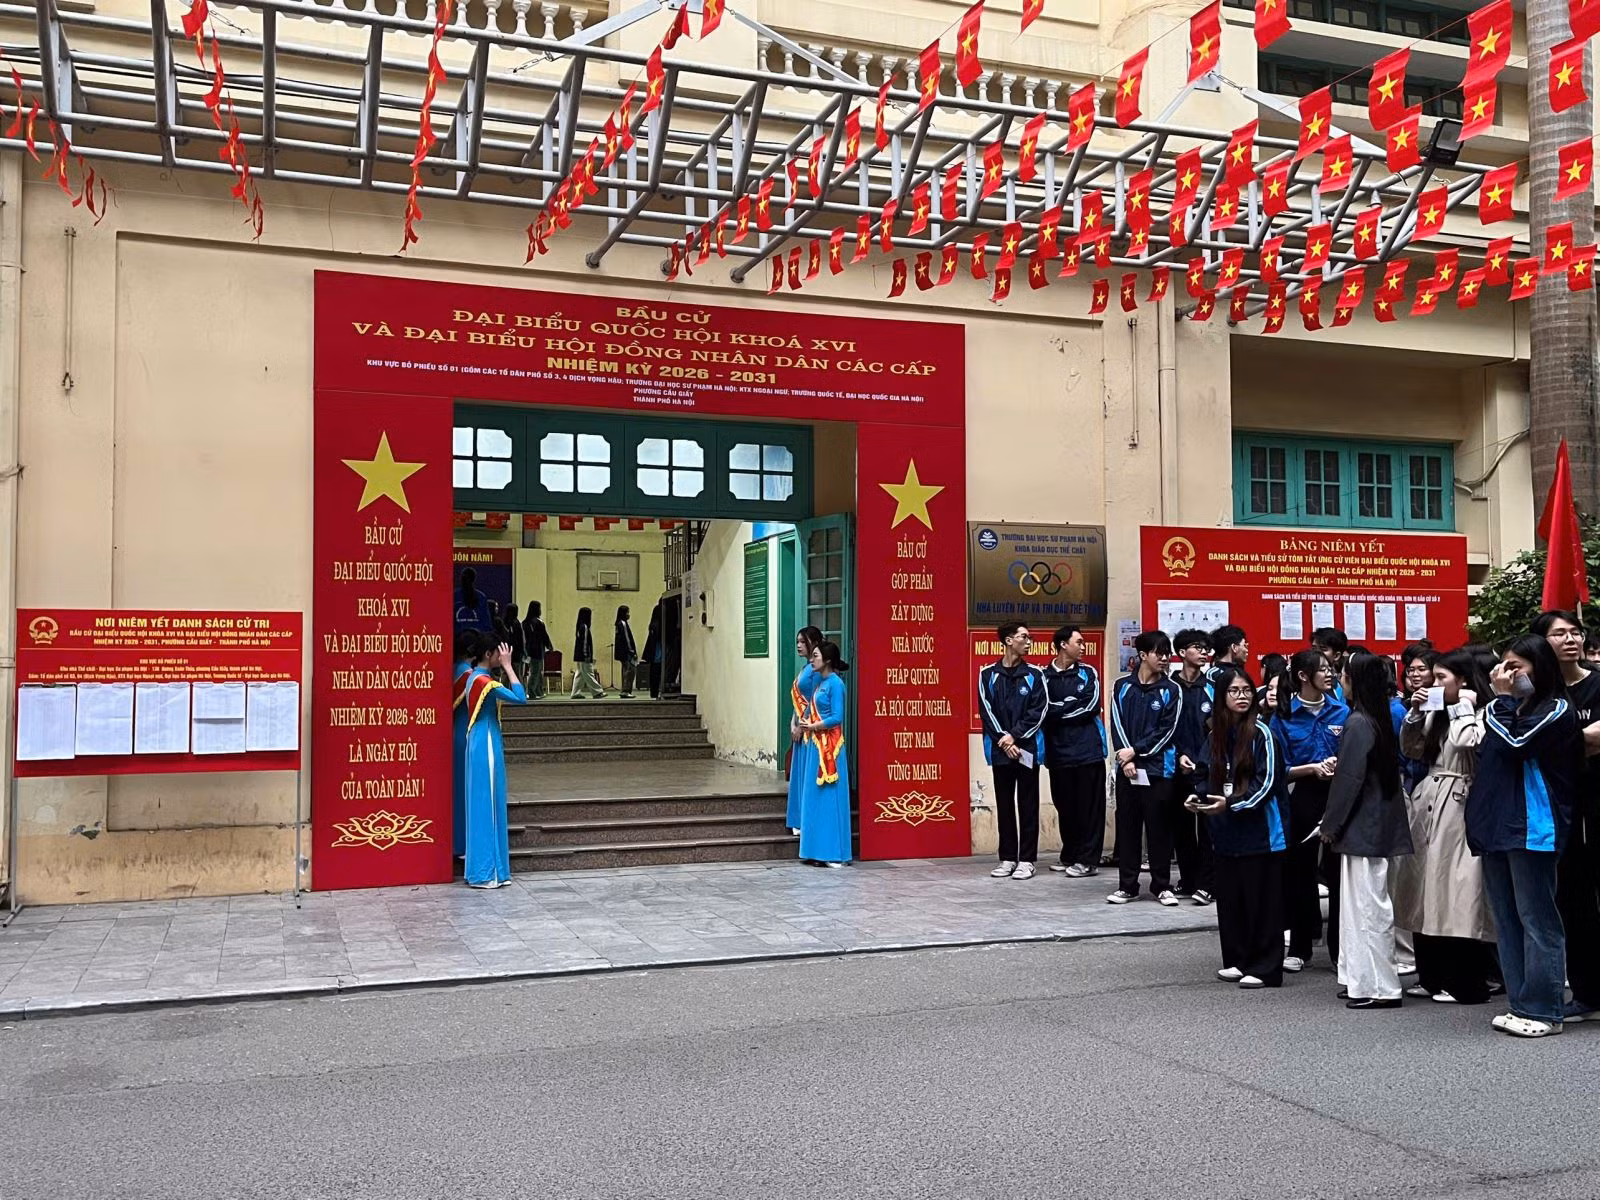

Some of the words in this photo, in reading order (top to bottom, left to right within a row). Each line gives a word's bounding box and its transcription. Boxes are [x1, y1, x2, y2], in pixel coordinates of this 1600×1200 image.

[617, 306, 667, 321] BẦU
[676, 310, 712, 324] CỬ
[453, 309, 505, 326] ĐẠI
[515, 311, 581, 331] BIỂU
[590, 322, 666, 338] QUỐC
[673, 328, 720, 345] HỘI
[730, 334, 803, 349] KHOÁ
[811, 339, 857, 352] XVI
[352, 321, 395, 337] VÀ
[404, 326, 458, 343] ĐẠI
[467, 328, 536, 348] BIỂU
[545, 337, 596, 354] HỘI
[605, 339, 683, 360] ĐỒNG
[691, 350, 767, 366] NHÂN
[775, 355, 830, 370] DÂN
[836, 359, 884, 373] CÁC
[890, 360, 936, 376] CẤP
[547, 357, 619, 374] NHIỆM
[625, 362, 653, 376] KỲ
[659, 366, 709, 379] 2026
[730, 371, 776, 384] 2031
[365, 516, 386, 544] BẦU
[389, 518, 403, 545] CỬ
[453, 552, 469, 562] UÔN
[897, 533, 913, 557] BẦU
[916, 534, 927, 558] CỬ
[1230, 552, 1249, 561] SÁCH
[1280, 537, 1317, 550] BẢNG
[1321, 538, 1355, 552] NIÊM
[1359, 538, 1385, 553] YẾT
[334, 562, 353, 584] ĐẠI
[356, 549, 381, 580] BIỂU
[384, 554, 412, 582] QUỐC
[415, 557, 433, 586] HỘI
[891, 568, 908, 589] GÓP
[910, 565, 933, 589] PHẦN
[1337, 566, 1350, 574] CÁC
[358, 593, 388, 616] KHOÁ
[391, 599, 409, 616] XVI
[891, 600, 909, 620] XÂY
[911, 603, 934, 625] DỰNG
[95, 617, 115, 627] NƠI
[118, 616, 147, 628] NIÊM
[151, 616, 170, 628] YẾT
[172, 618, 202, 628] DANH
[205, 617, 234, 628] SÁCH
[236, 616, 252, 629] CỬ
[254, 619, 270, 628] TRI
[324, 629, 339, 652] VÀ
[342, 635, 360, 657] ĐẠI
[364, 622, 388, 653] BIỂU
[391, 628, 410, 658] HỘI
[413, 625, 442, 653] ĐỒNG
[892, 632, 910, 652] NHÀ
[912, 632, 934, 652] NƯỚC
[975, 641, 989, 655] NƠI
[1085, 641, 1097, 655] TRI
[333, 665, 363, 689] NHÂN
[367, 665, 389, 689] DÂN
[392, 665, 412, 689] CÁC
[414, 662, 433, 688] CẤP
[887, 663, 908, 684] PHÁP
[911, 660, 939, 685] QUYỀN
[330, 701, 366, 731] NHIỆM
[369, 702, 383, 725] KỲ
[387, 708, 408, 725] 2026
[416, 708, 435, 724] 2031
[875, 696, 887, 716] XÃ
[889, 694, 904, 720] HỘI
[906, 692, 922, 716] CHỦ
[925, 696, 952, 716] NGHĨA
[349, 738, 363, 762] LÀ
[366, 738, 395, 762] NGÀY
[398, 737, 417, 766] HỘI
[894, 726, 913, 752] VIỆT
[915, 732, 934, 748] NAM
[888, 760, 910, 780] VỮNG
[342, 772, 363, 799] CỦA
[366, 774, 394, 798] TOÀN
